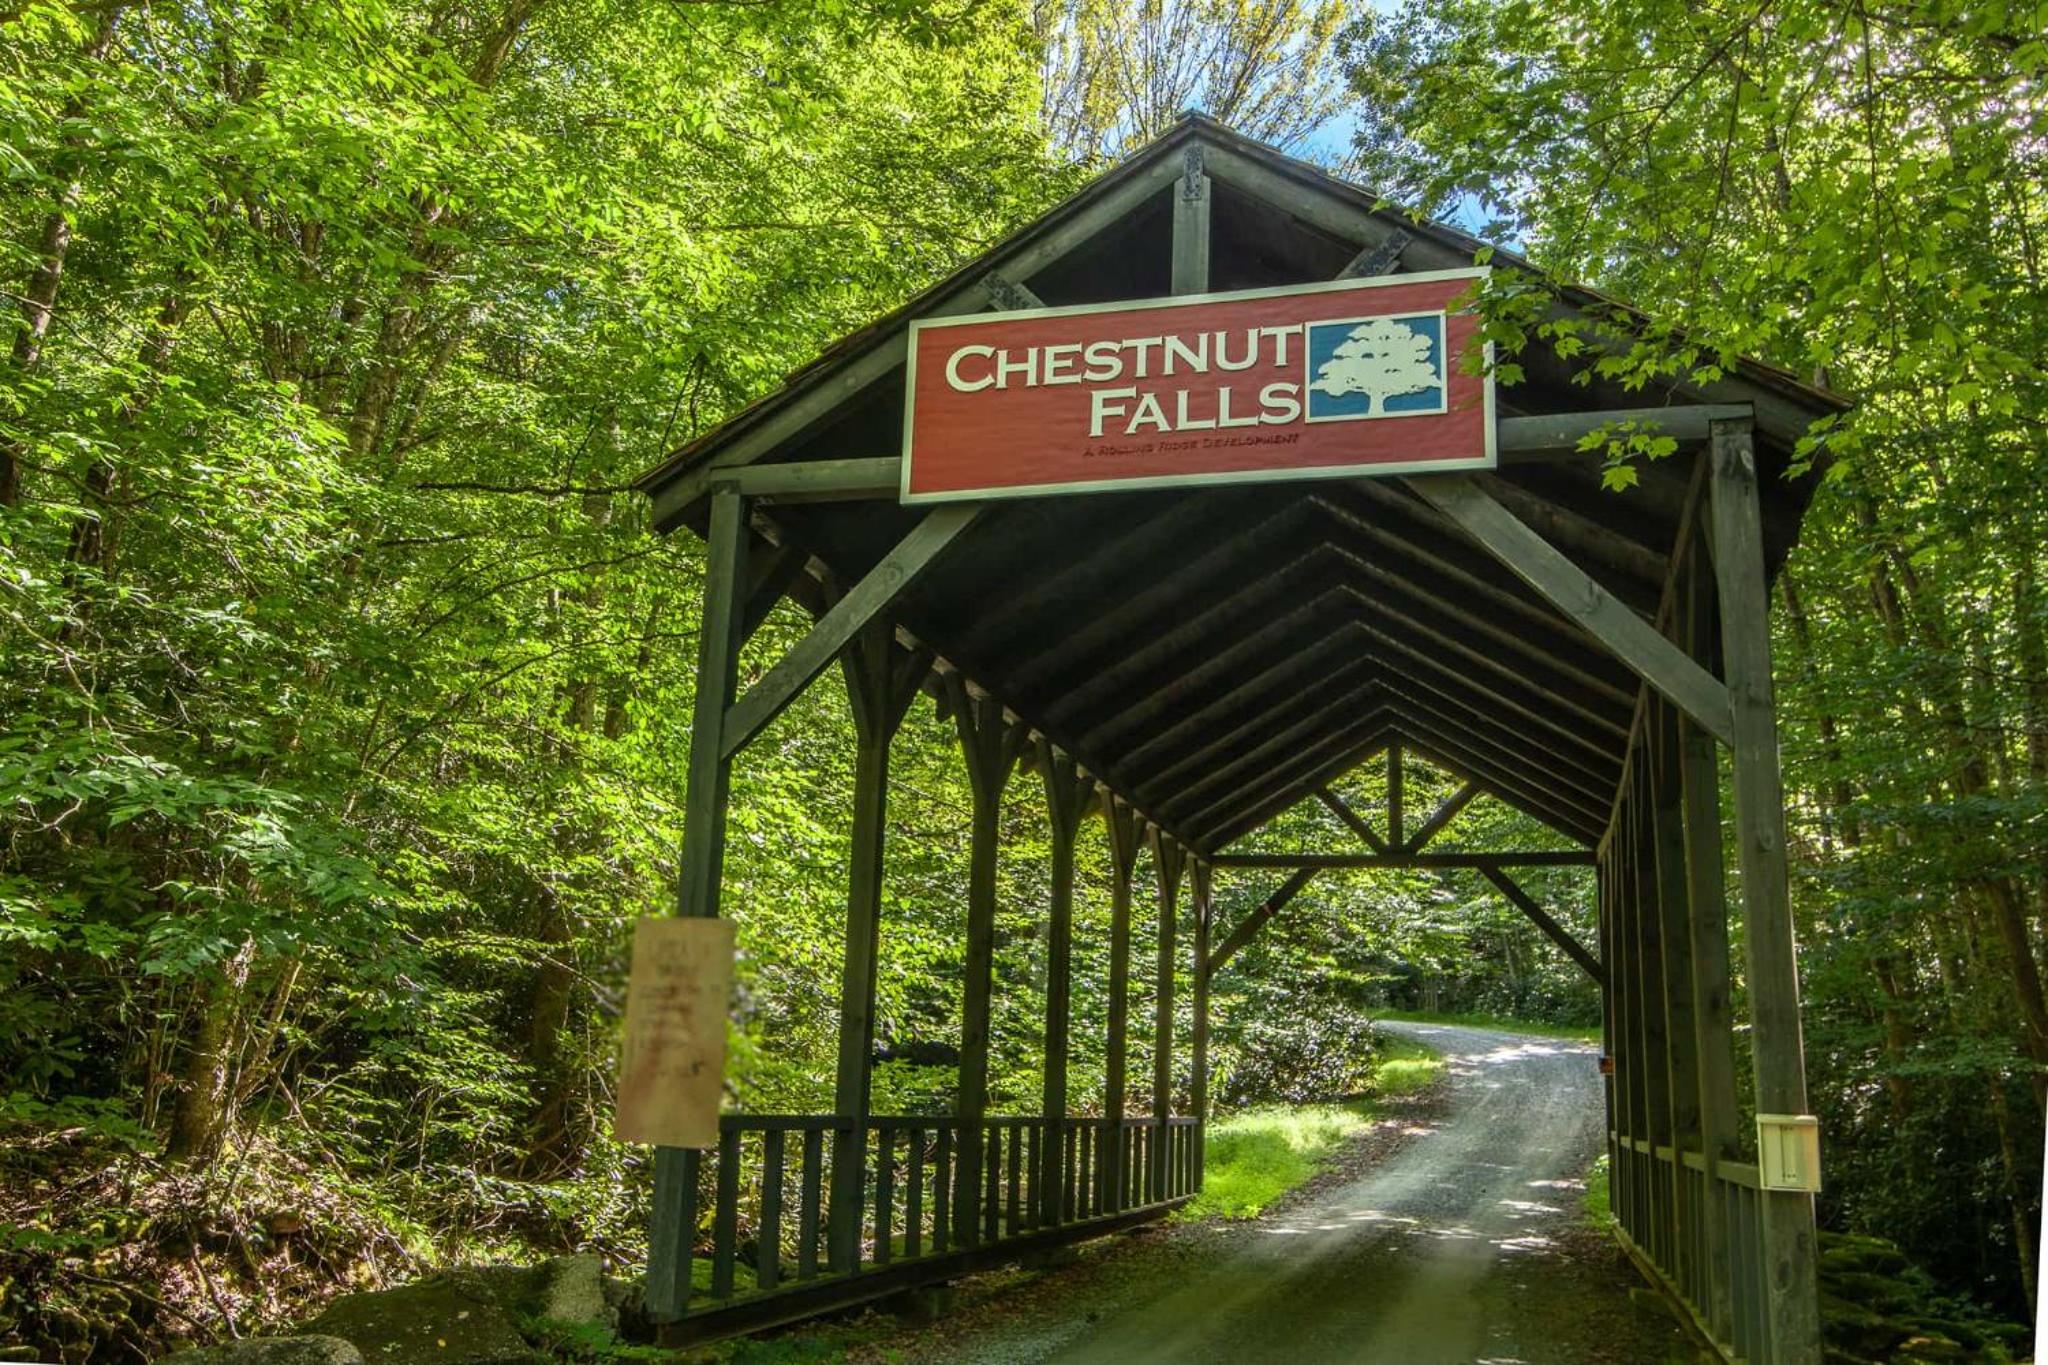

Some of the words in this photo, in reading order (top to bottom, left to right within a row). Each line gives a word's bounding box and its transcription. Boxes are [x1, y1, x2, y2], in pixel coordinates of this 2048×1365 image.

[945, 323, 1303, 393] CHESTNUT
[1088, 382, 1302, 438] FALLS
[1203, 433, 1299, 450] DEVELOPMENT
